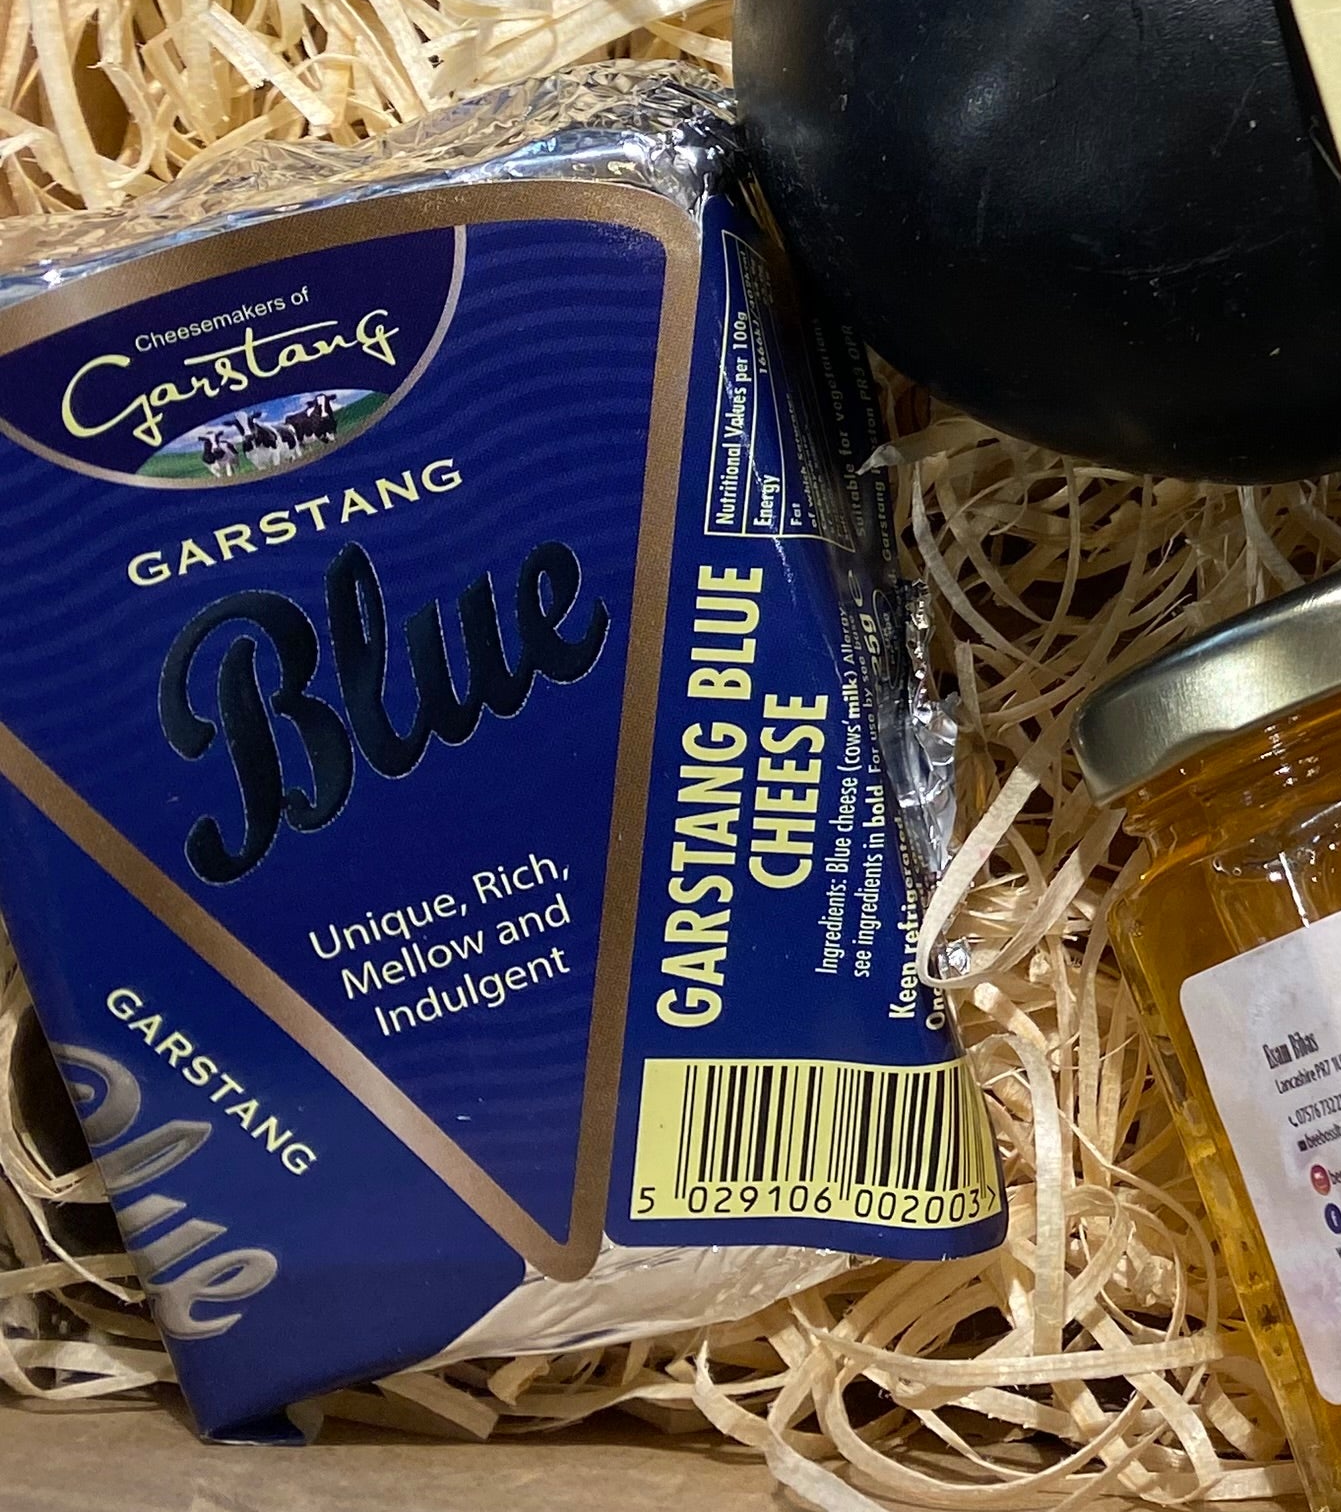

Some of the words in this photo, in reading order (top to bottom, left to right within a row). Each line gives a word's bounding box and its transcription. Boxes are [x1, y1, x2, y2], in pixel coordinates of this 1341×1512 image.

[135, 295, 285, 352] Cheesemakers
[290, 286, 309, 305] of
[733, 311, 748, 351] 100g
[62, 309, 400, 448] Garstang
[735, 356, 752, 383] per
[724, 386, 747, 437] Values
[837, 429, 853, 456] for
[715, 438, 741, 525] Nutritional
[754, 474, 781, 527] Energy
[127, 458, 463, 588] GARSTANG
[790, 502, 803, 527] Fat
[872, 480, 892, 562] Garstang
[687, 564, 763, 700] BLUE
[157, 540, 612, 887] Blue
[840, 670, 861, 719] milk)
[862, 688, 873, 707] by
[867, 746, 882, 773] For
[748, 692, 828, 890] CHEESE
[829, 777, 859, 832] cheese
[824, 838, 851, 872] Blue
[862, 833, 885, 849] in
[656, 721, 748, 1028] GARSTANG
[852, 853, 884, 945] ingredients
[308, 892, 468, 962] Unique,
[472, 853, 570, 907] Rich,
[815, 878, 847, 974] Ingredients:
[340, 929, 485, 999] Mellow
[497, 893, 571, 945] and
[853, 951, 872, 977] see
[373, 946, 569, 1037] Indulgent
[888, 962, 917, 1018] Keep
[105, 986, 318, 1176] GARSTANG
[1274, 1067, 1317, 1094] Lancashire
[637, 1186, 656, 1212] 5
[688, 1185, 832, 1213] 029106
[854, 1185, 981, 1224] 002003
